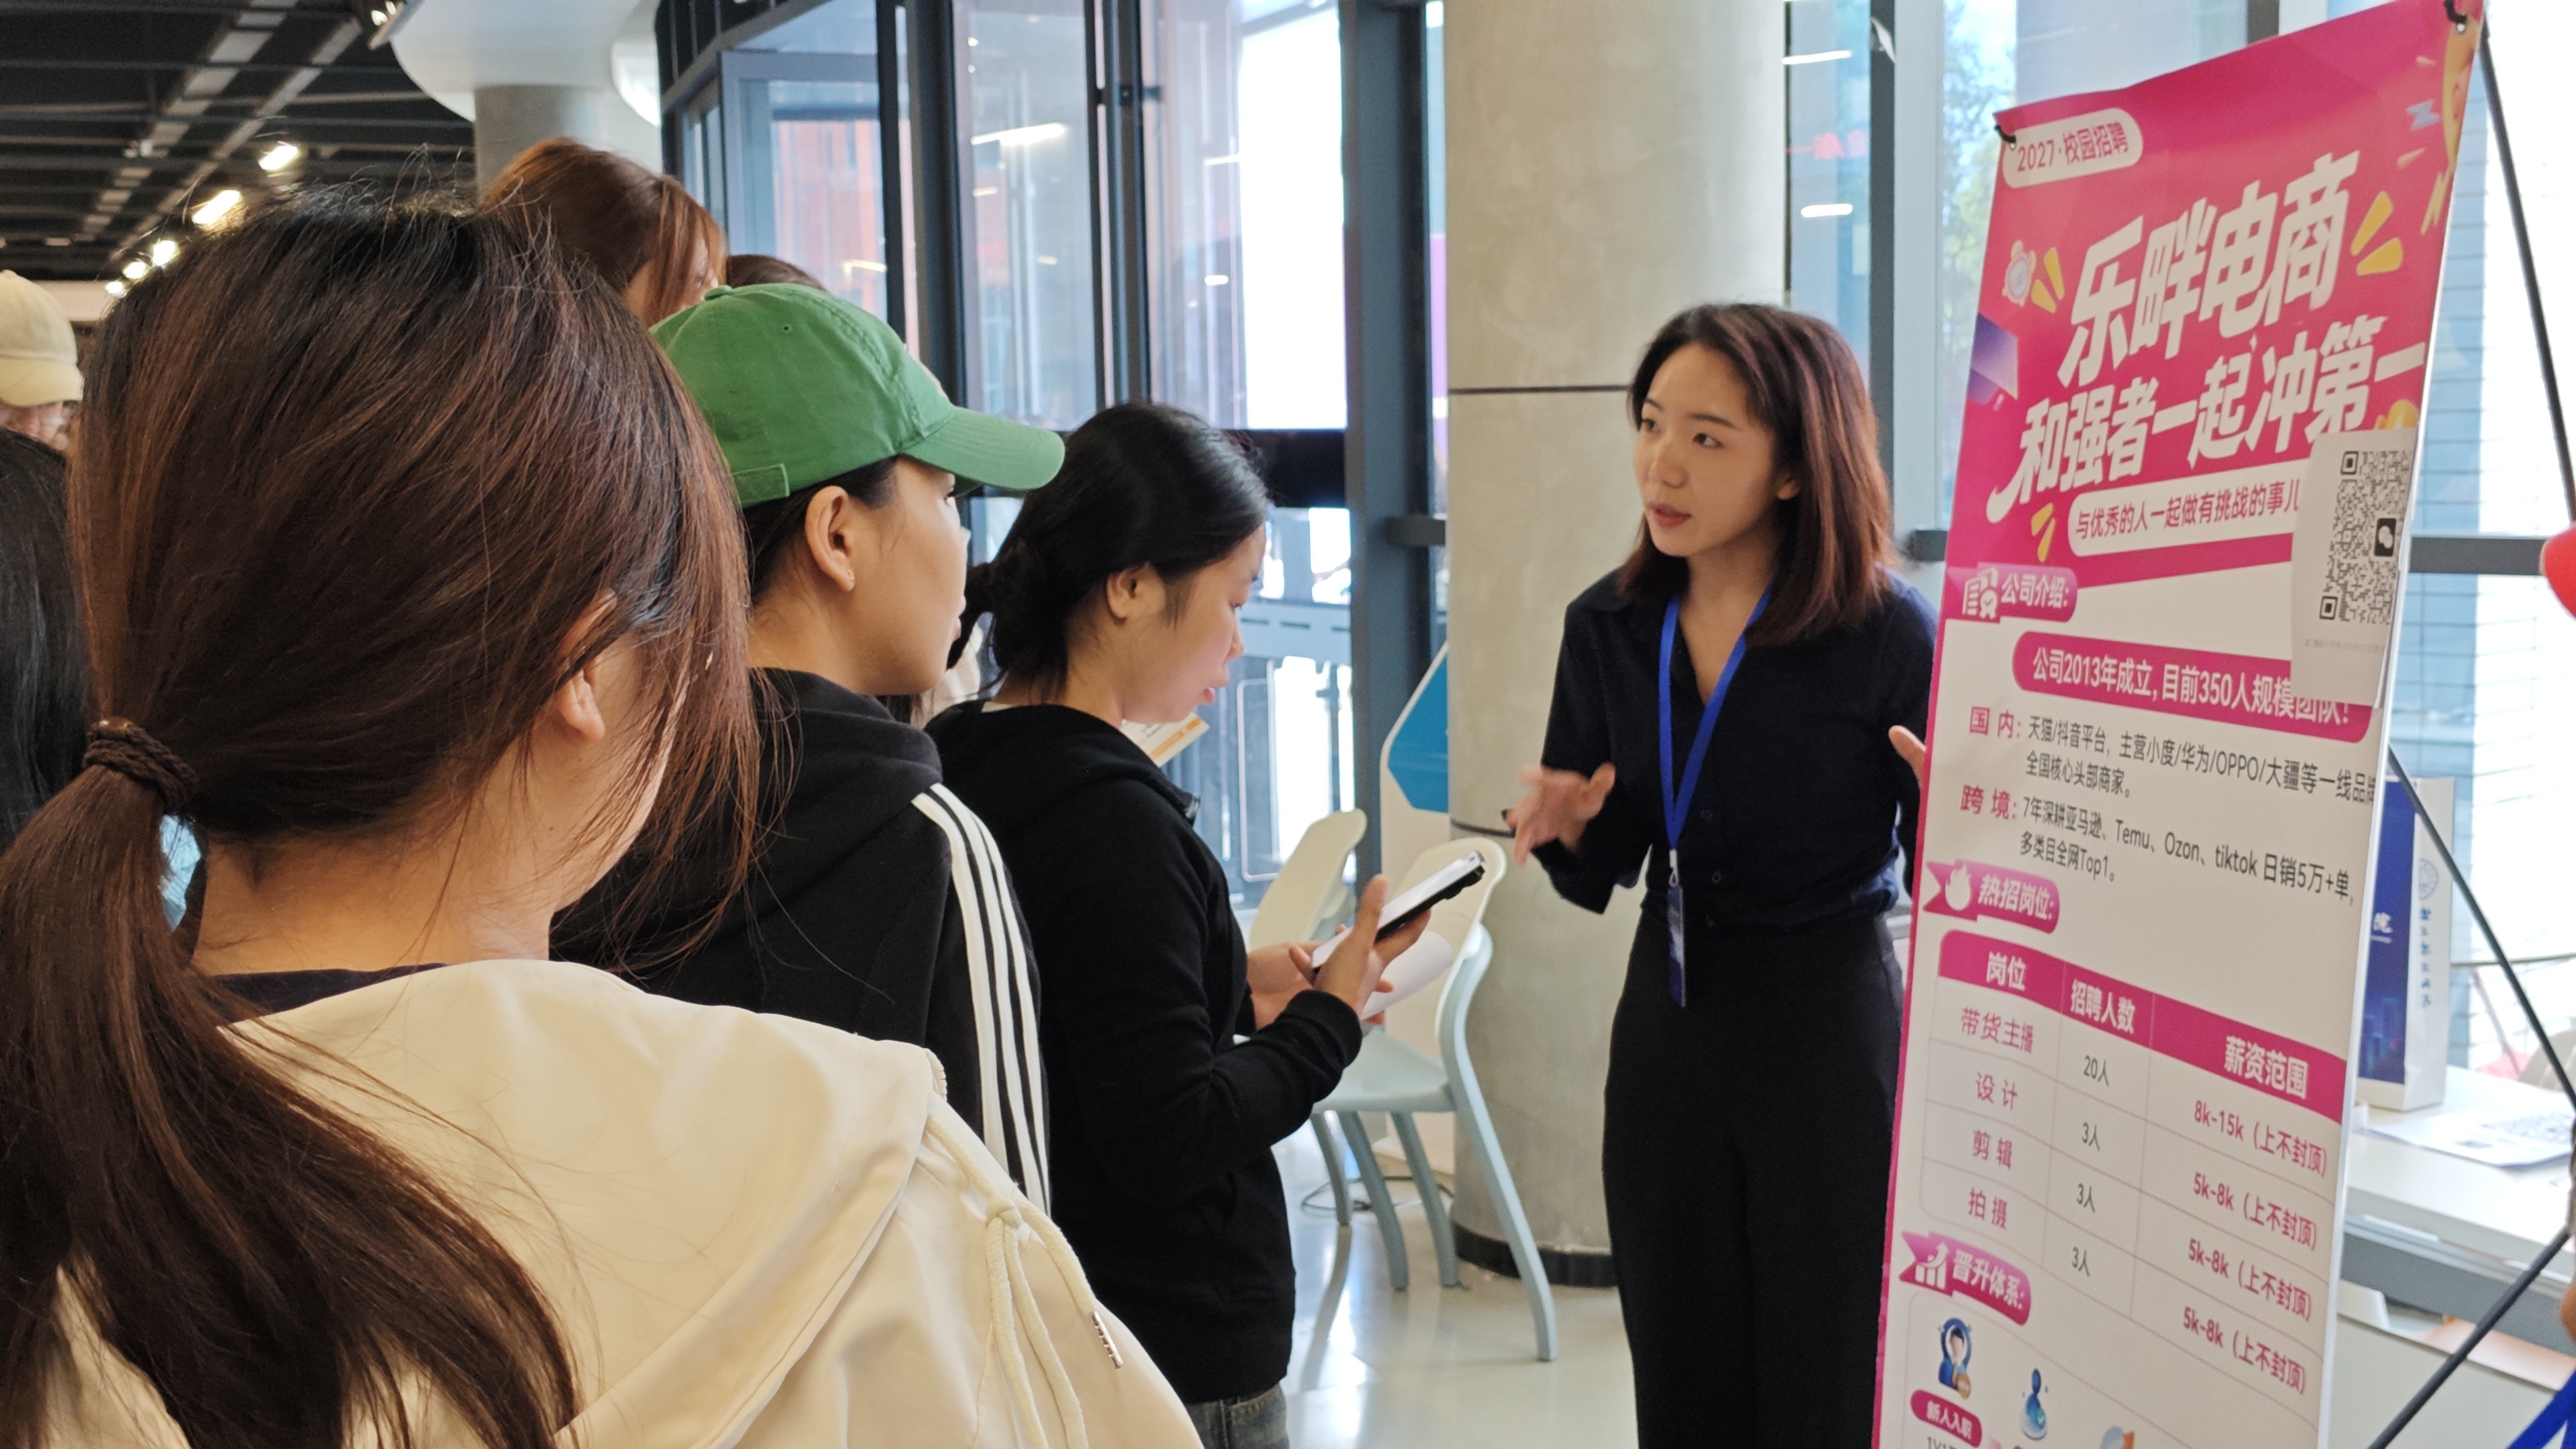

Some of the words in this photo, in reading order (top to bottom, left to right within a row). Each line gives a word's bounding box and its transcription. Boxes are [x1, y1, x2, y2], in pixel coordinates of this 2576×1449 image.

[2017, 120, 2128, 172] 2027·校园招聘
[2057, 150, 2360, 388] 乐畔电商
[1986, 314, 2425, 523] 和强者一起冲第一
[2076, 479, 2300, 540] 与优秀的人一起做有挑战的事儿
[2001, 573, 2069, 609] 公司介绍:
[2026, 750, 2129, 798] 全国核心头部商家。
[2020, 830, 2114, 882] 多类目全网Top1。
[1978, 873, 2054, 920] 热招岗位:
[1986, 951, 2027, 991] 岗位
[1960, 1006, 2033, 1054] 带货主播
[2070, 979, 2136, 1035] 招聘人数
[1975, 1071, 2018, 1110] 设计
[2083, 1055, 2109, 1086] 20人
[2224, 1035, 2309, 1100] 薪资范围
[1972, 1130, 2012, 1170] 剪辑
[2082, 1121, 2100, 1151] 3人
[1968, 1186, 2007, 1230] 拍摄
[2077, 1182, 2095, 1213] 3人
[1952, 1248, 2024, 1310] 晋升体系:
[2072, 1246, 2090, 1277] 3人
